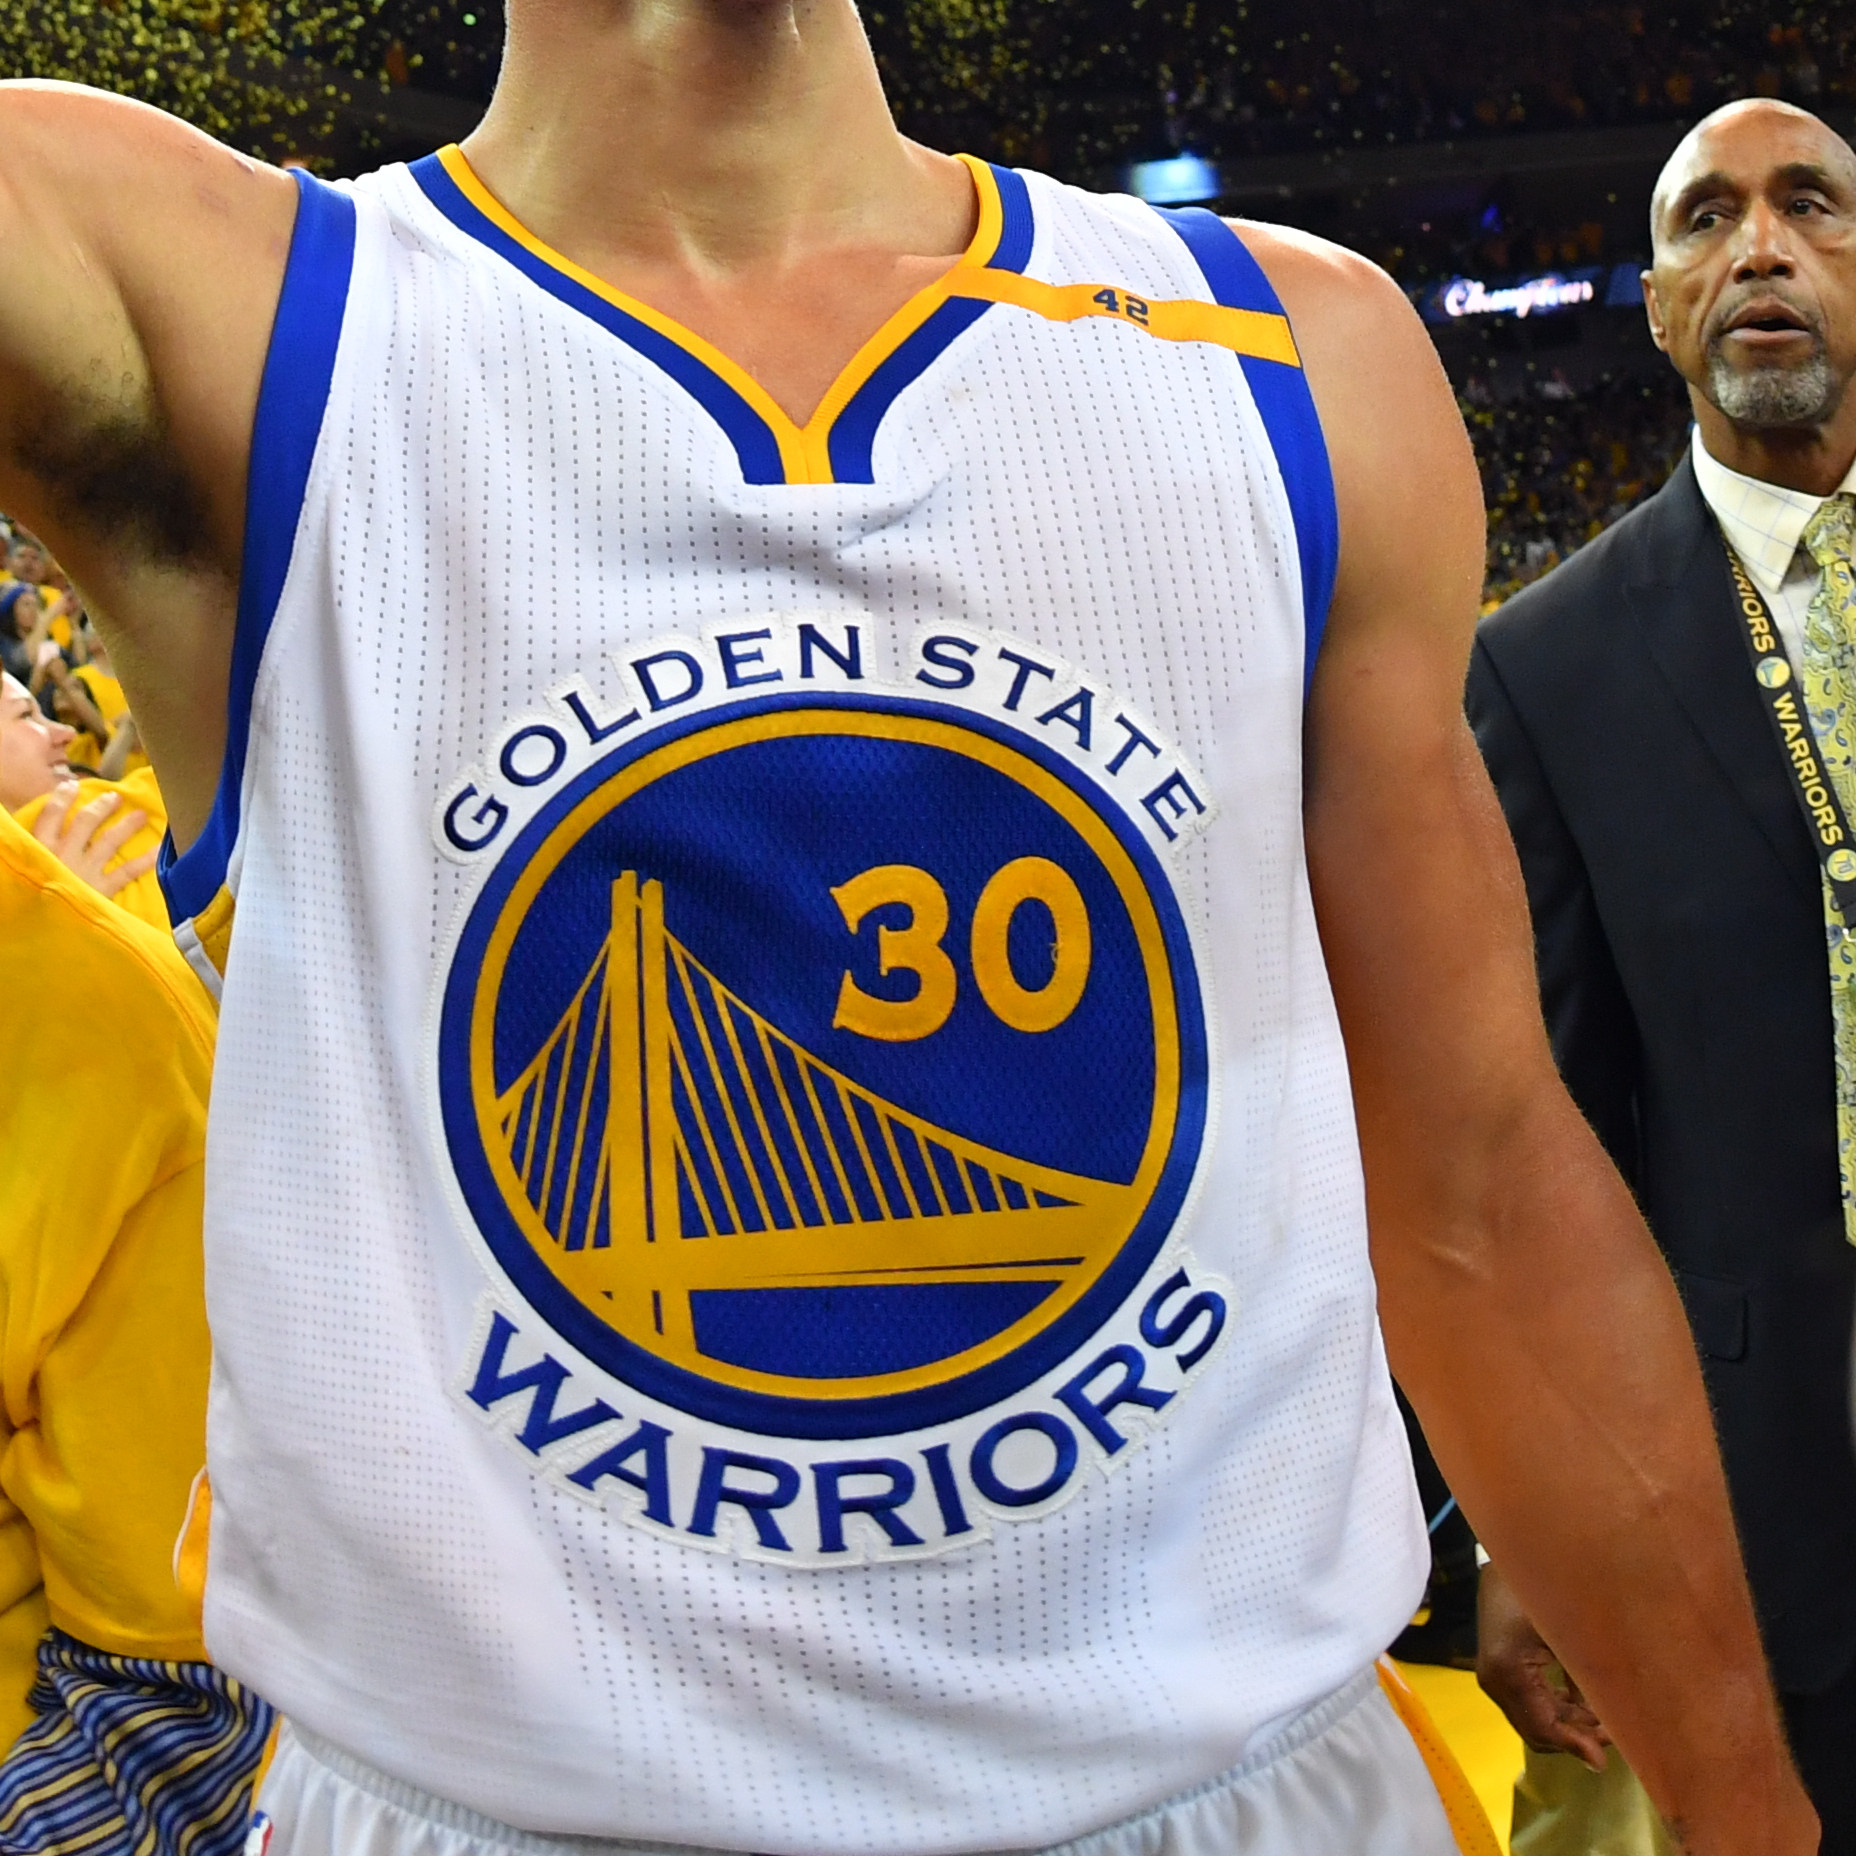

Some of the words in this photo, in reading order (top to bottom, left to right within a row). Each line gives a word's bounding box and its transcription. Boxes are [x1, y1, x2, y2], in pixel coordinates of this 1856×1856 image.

[1092, 288, 1150, 327] 42
[442, 622, 863, 854] GOLDEN
[916, 634, 1208, 844] STATE
[1772, 690, 1843, 846] WARRIORS
[829, 855, 1093, 1043] 30
[464, 1267, 1230, 1555] WARRIORS
